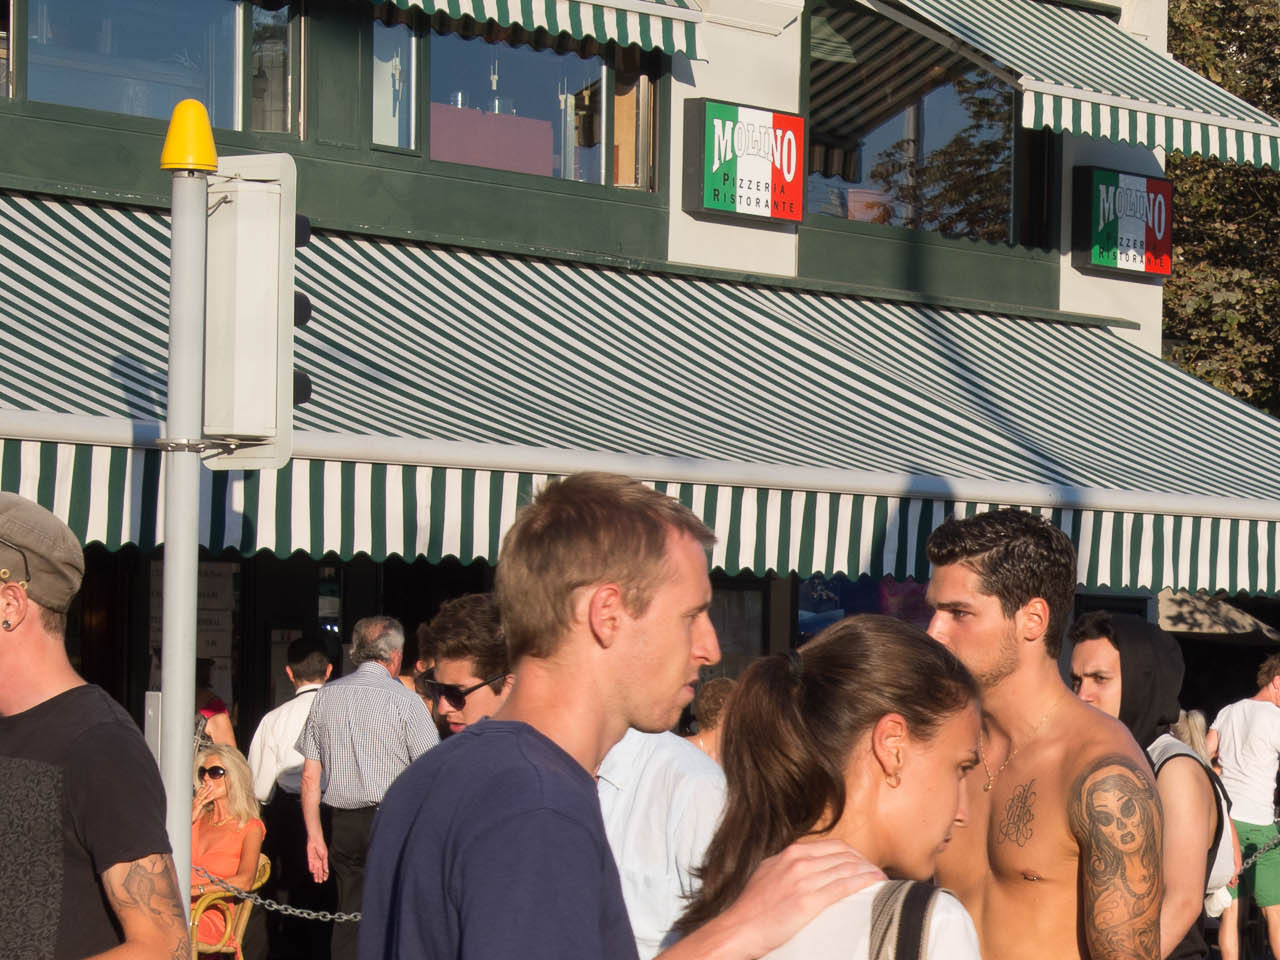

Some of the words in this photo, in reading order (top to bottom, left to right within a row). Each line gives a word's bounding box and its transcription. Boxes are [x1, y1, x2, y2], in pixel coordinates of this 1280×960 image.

[712, 118, 797, 183] MOLINO
[722, 172, 786, 194] PIZZERIA
[713, 188, 795, 213] RISTORANTE
[1098, 184, 1166, 240] MOLINO
[1105, 231, 1158, 251] ZZER
